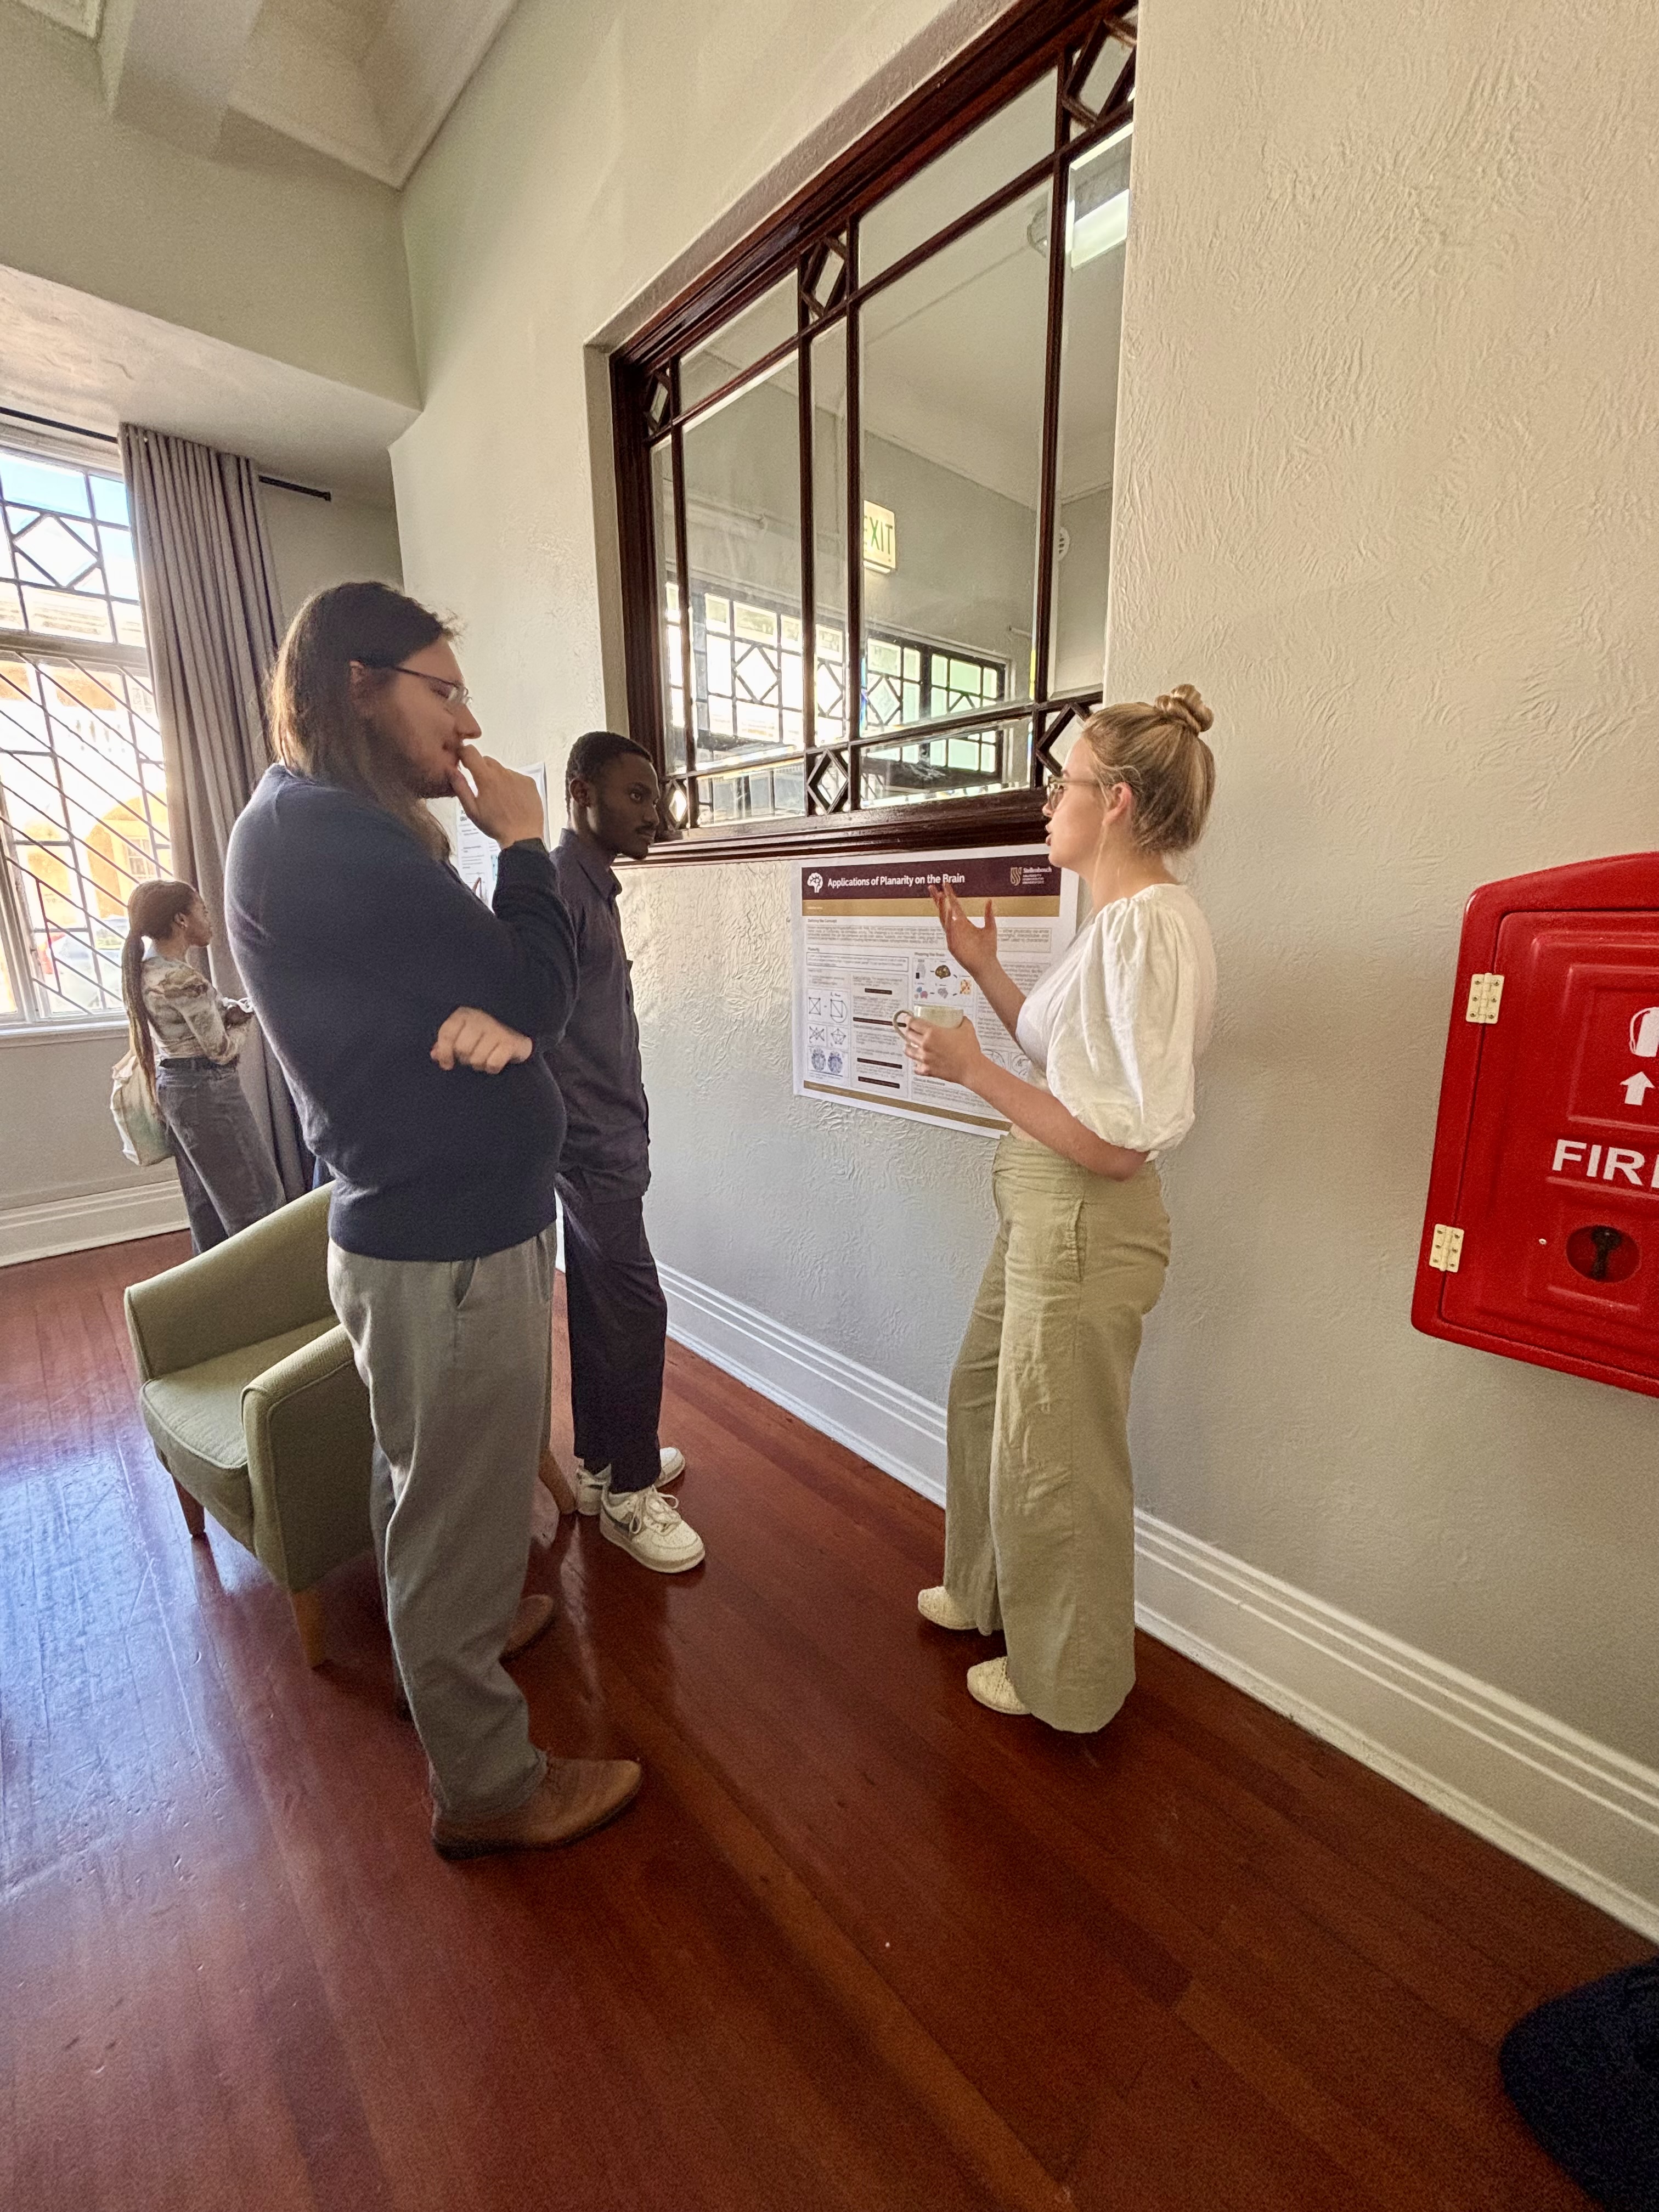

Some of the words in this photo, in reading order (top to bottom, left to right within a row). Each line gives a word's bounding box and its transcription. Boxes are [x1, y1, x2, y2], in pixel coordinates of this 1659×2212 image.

[827, 877, 870, 889] Applications
[871, 876, 879, 886] of
[879, 875, 914, 887] Planarity
[915, 876, 926, 884] on
[927, 873, 941, 884] the
[943, 872, 966, 884] Brain
